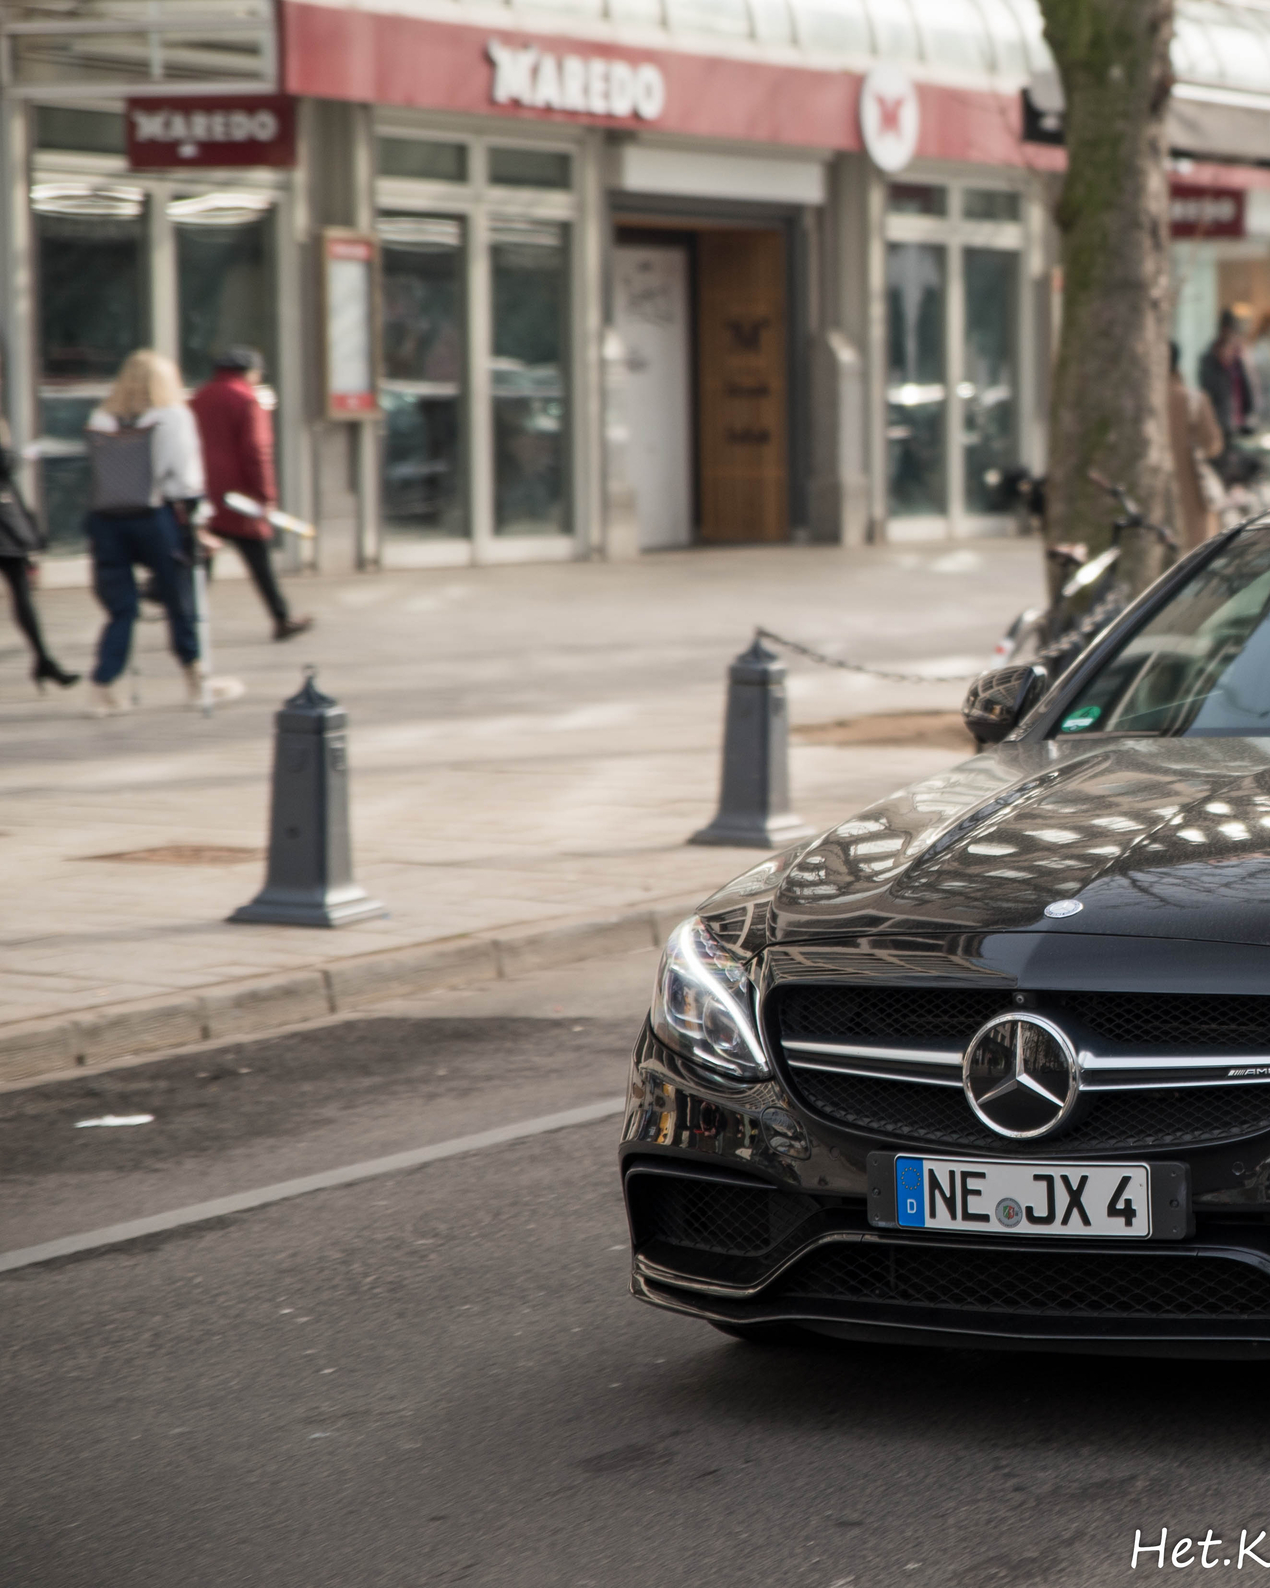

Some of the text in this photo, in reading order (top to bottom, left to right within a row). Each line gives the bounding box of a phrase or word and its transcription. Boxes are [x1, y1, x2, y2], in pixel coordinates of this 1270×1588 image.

[488, 38, 665, 119] MAREDO
[132, 107, 278, 142] MAREDO
[907, 1199, 917, 1214] D
[927, 1167, 991, 1223] NE
[1025, 1173, 1093, 1227] JX
[1106, 1175, 1137, 1227] 4
